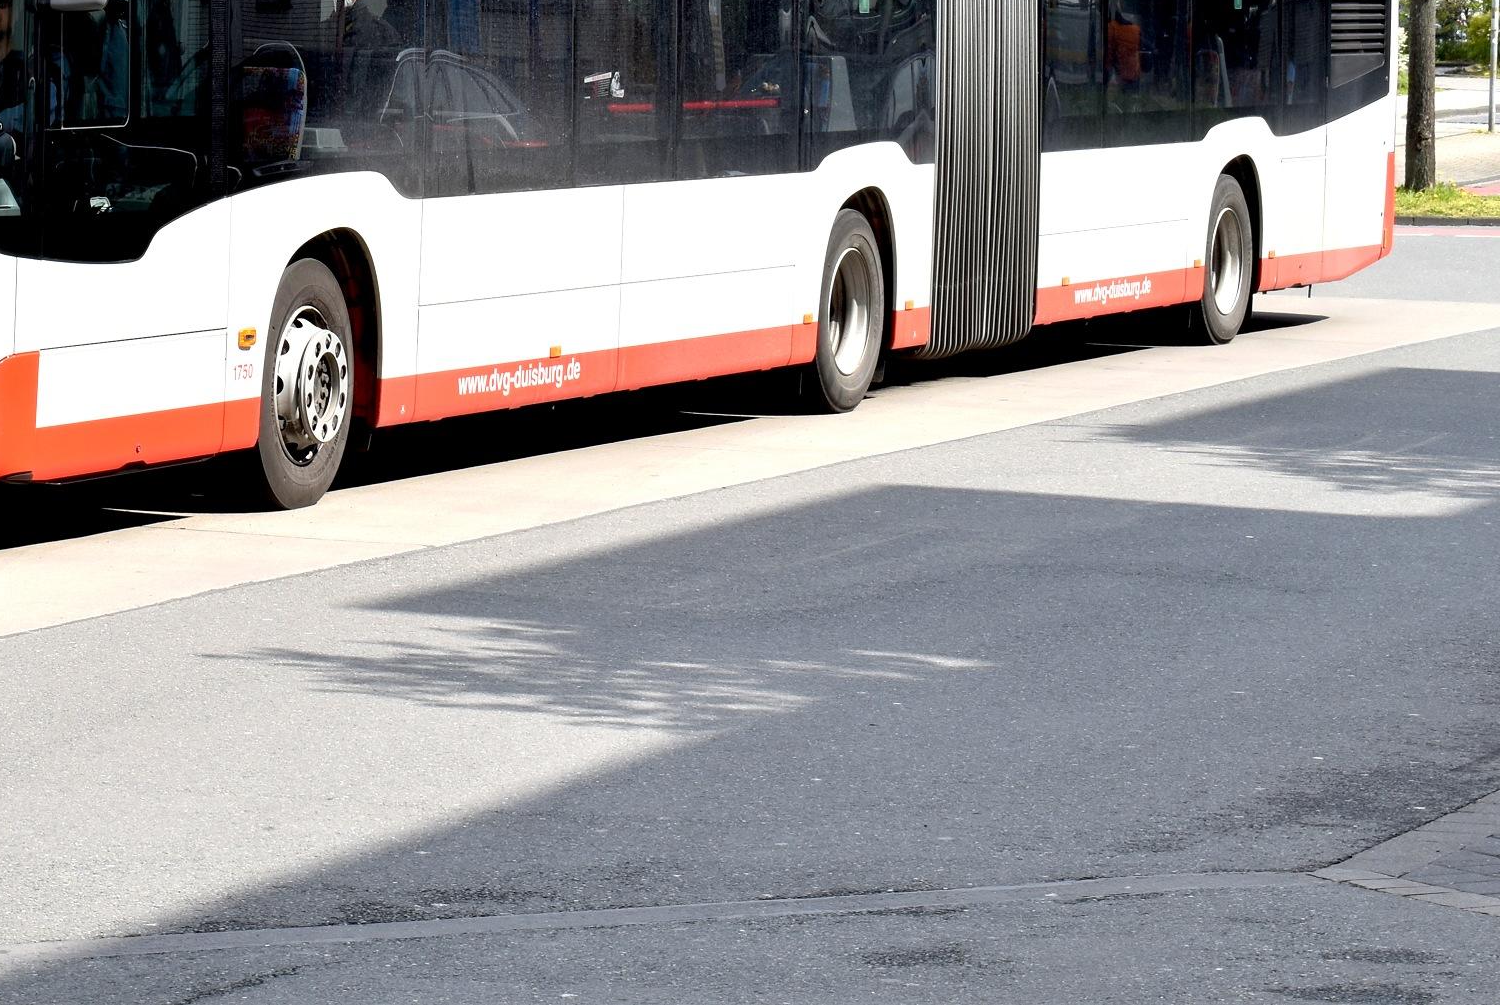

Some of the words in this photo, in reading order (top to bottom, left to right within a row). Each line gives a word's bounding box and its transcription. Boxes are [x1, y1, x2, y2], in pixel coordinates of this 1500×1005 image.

[1074, 276, 1152, 305] www.dvg-duisburg.de
[232, 363, 254, 381] 1750
[458, 357, 581, 396] www.dvg-duisburg.de
